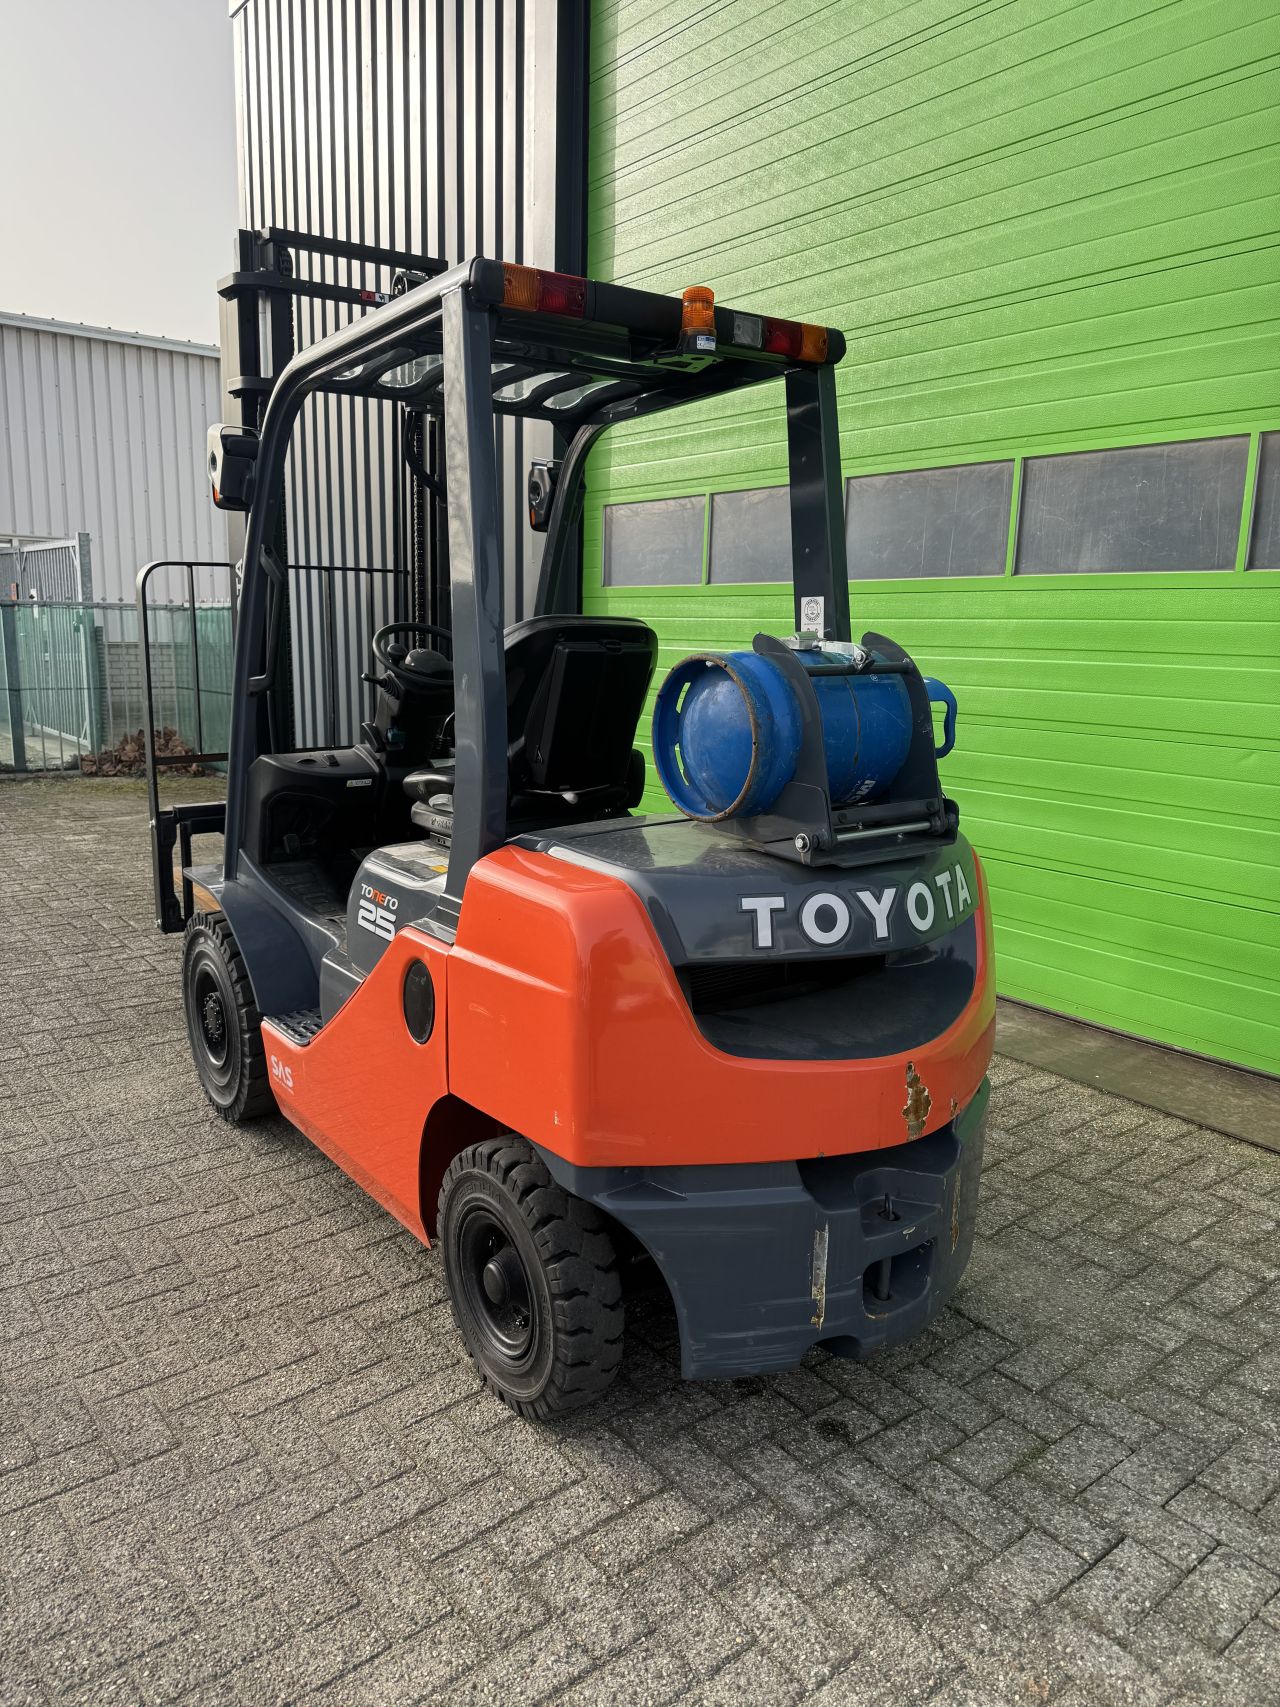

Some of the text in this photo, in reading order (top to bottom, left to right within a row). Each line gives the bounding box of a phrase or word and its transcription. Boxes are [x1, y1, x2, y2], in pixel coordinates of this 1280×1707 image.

[357, 898, 397, 942] 25
[741, 863, 972, 947] TOYOTA
[270, 1054, 294, 1088] SAS
